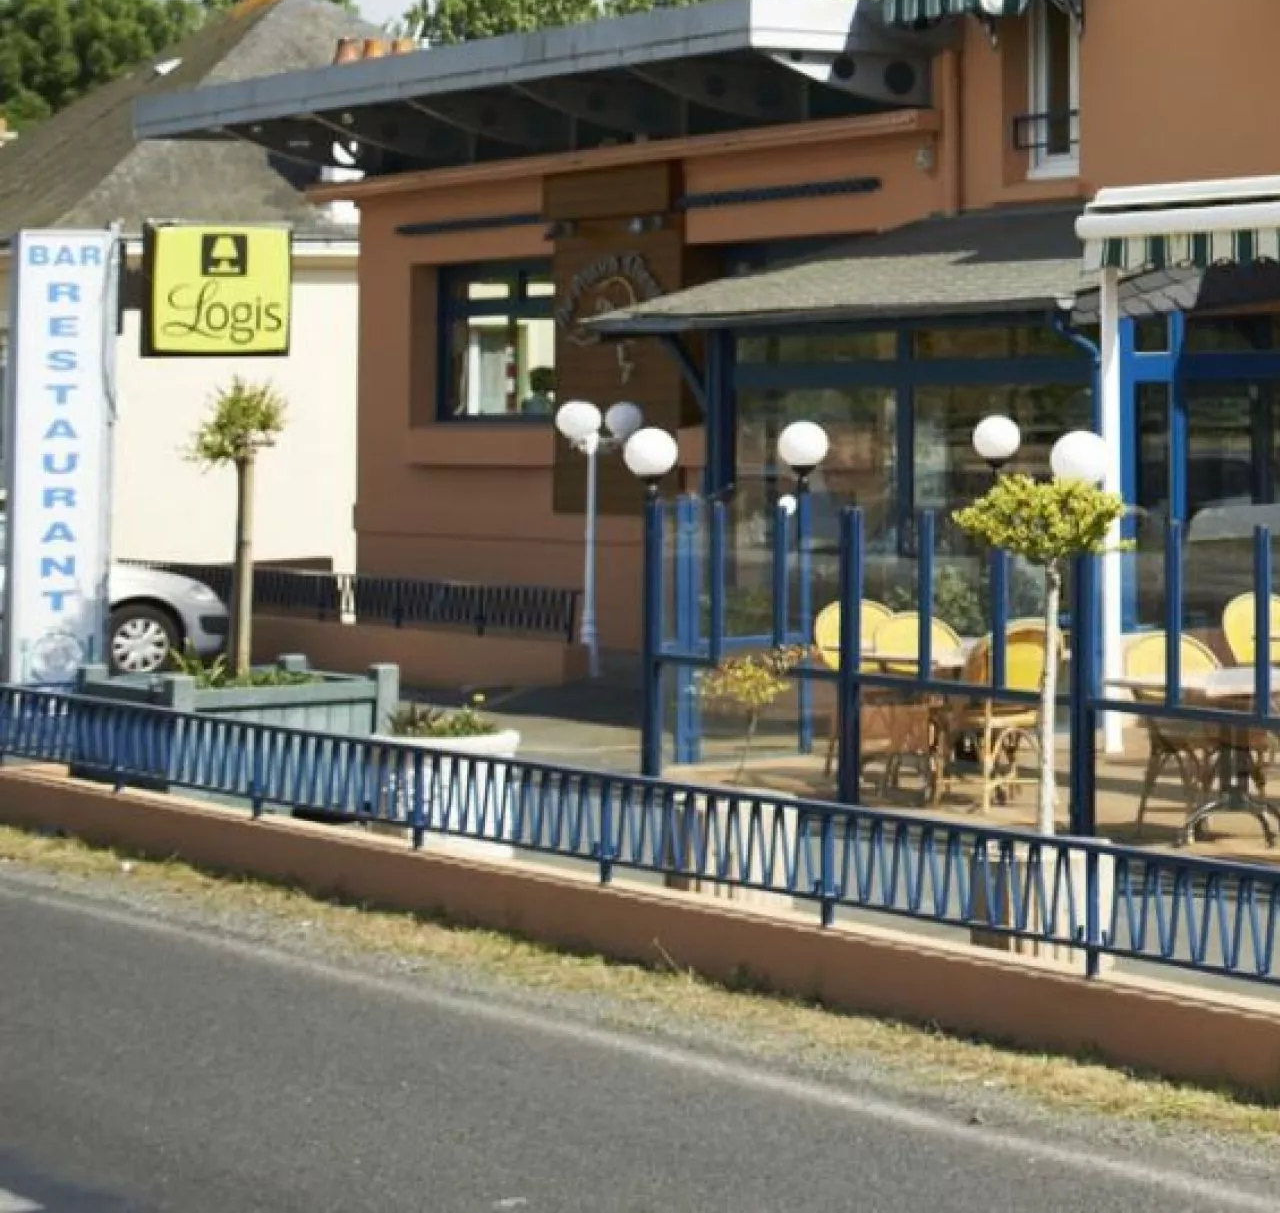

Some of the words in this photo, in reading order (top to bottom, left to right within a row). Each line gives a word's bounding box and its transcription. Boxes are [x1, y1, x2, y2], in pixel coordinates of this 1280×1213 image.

[28, 245, 101, 266] BAR
[161, 280, 283, 346] Logis
[41, 282, 81, 611] RESTAURANT
